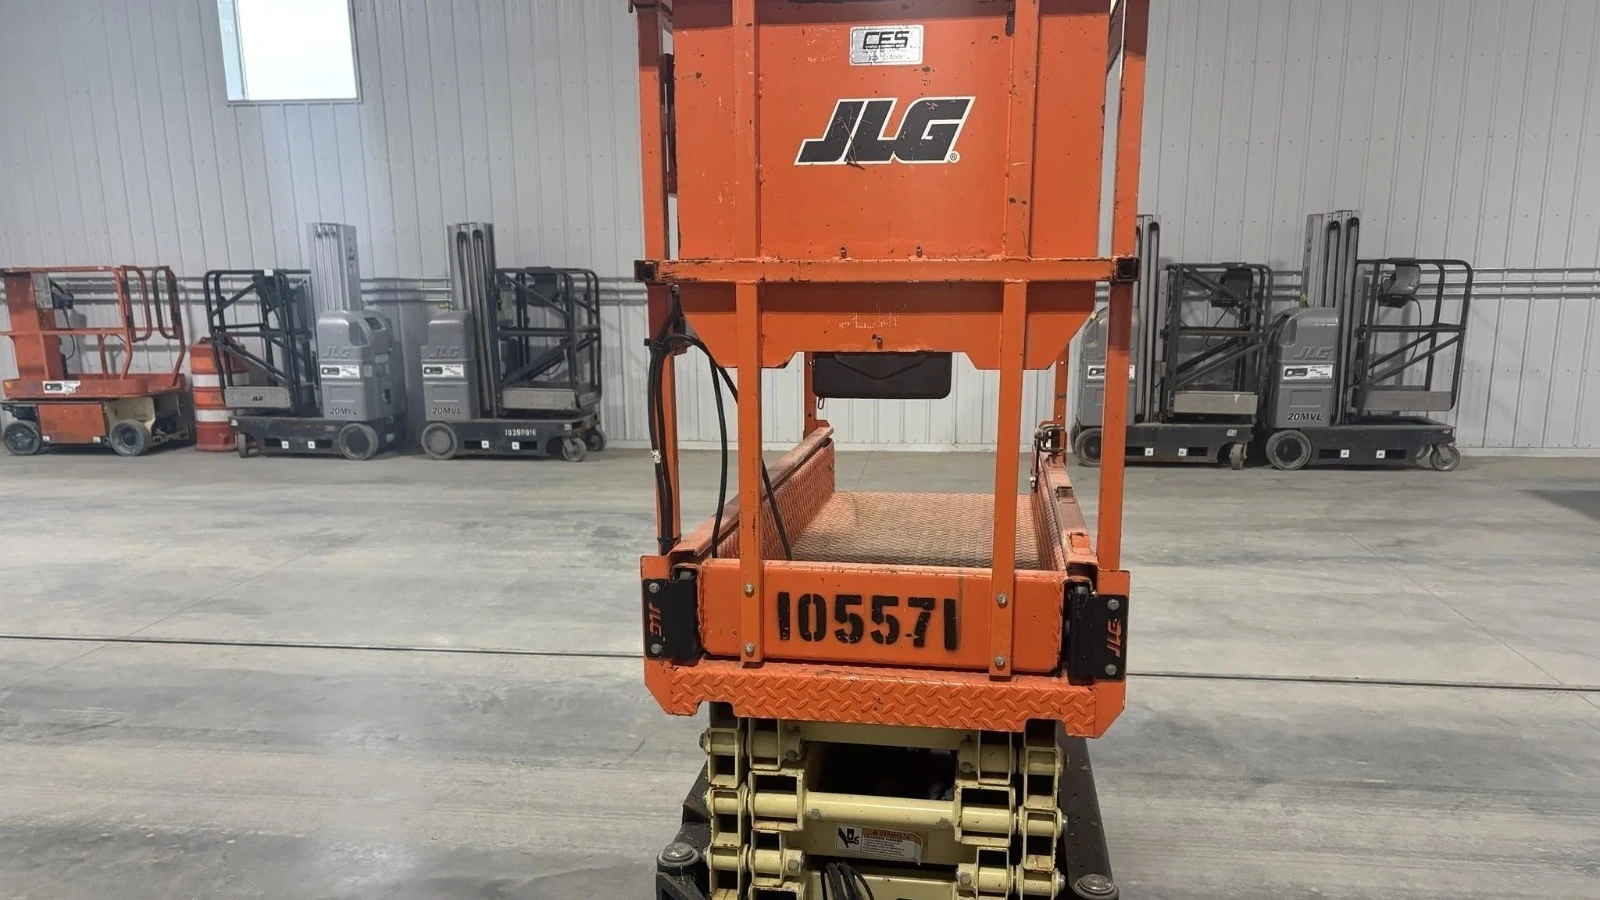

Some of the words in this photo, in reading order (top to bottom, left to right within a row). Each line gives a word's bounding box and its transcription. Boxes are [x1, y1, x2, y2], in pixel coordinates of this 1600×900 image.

[863, 31, 910, 50] CES
[794, 97, 976, 164] JLG
[1294, 346, 1333, 360] JLG
[431, 406, 462, 415] 20MVL
[1287, 412, 1323, 421] 20MVL
[648, 601, 662, 637] JLG
[777, 591, 958, 651] 105571
[1106, 618, 1122, 658] JLG
